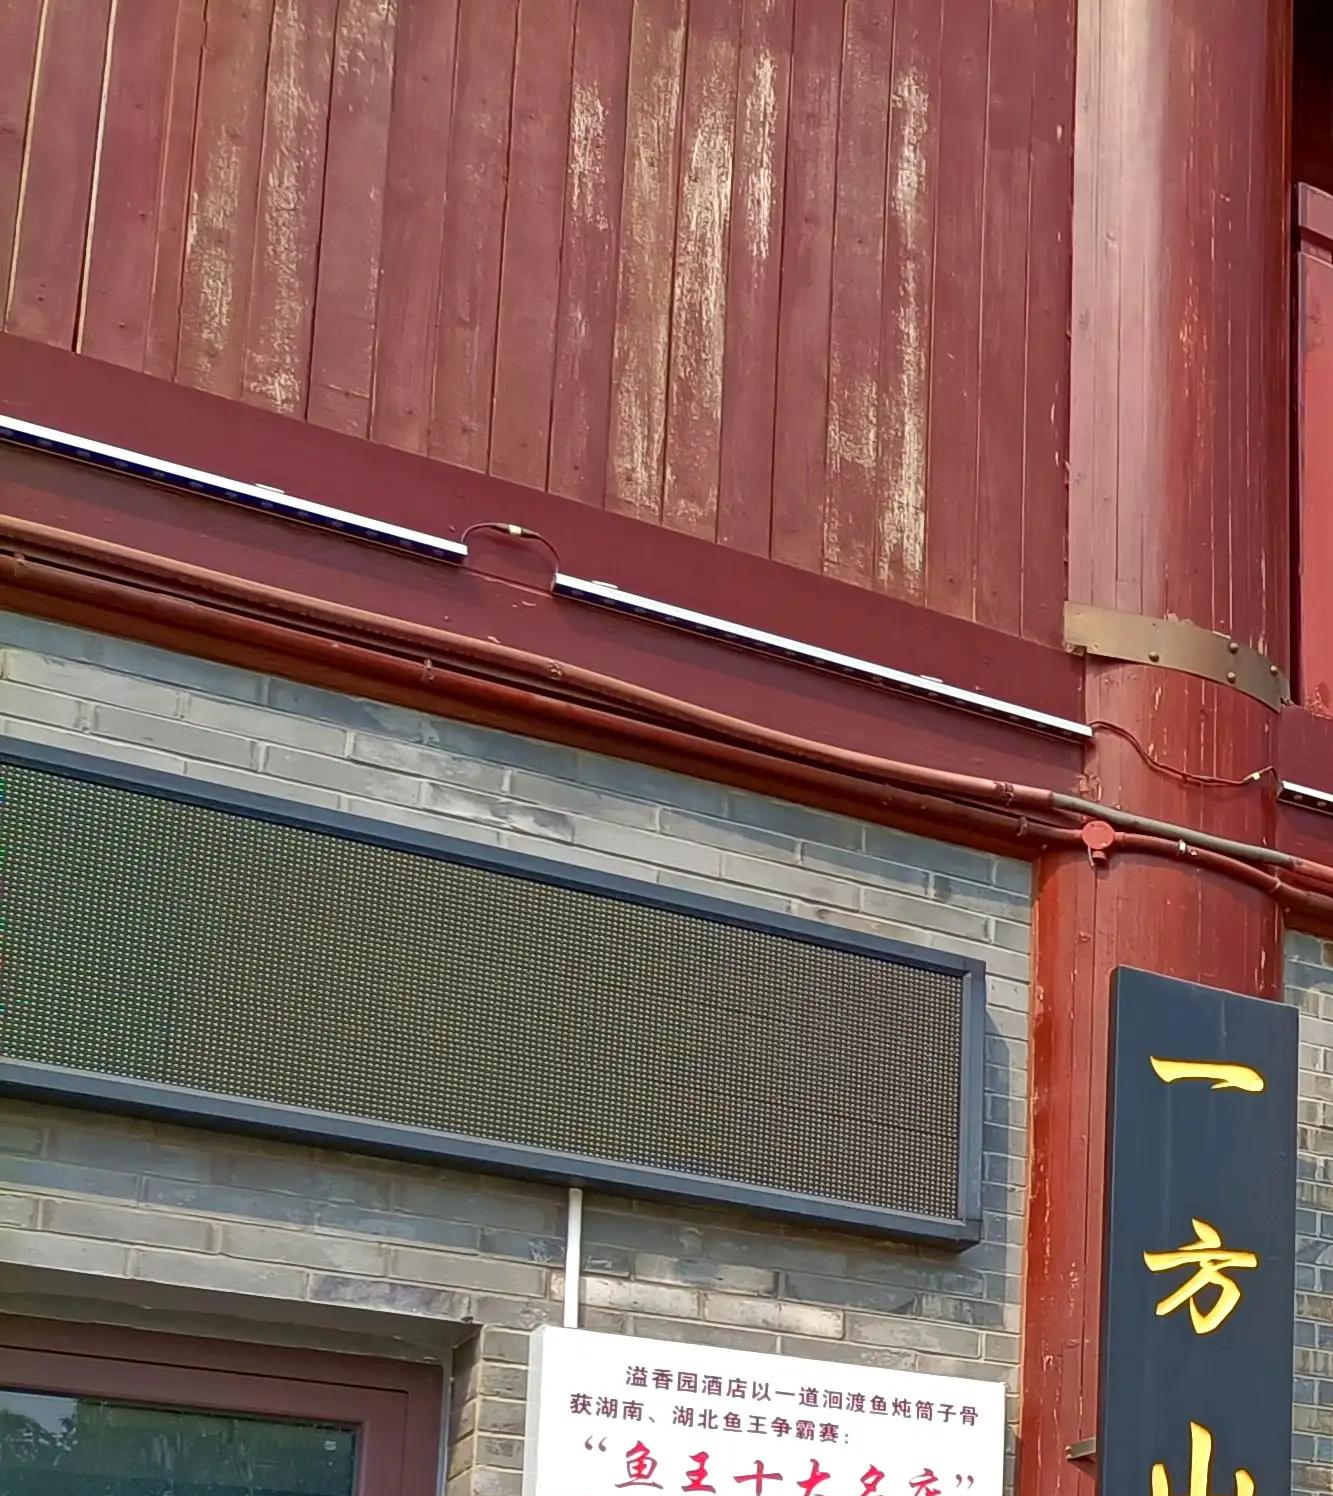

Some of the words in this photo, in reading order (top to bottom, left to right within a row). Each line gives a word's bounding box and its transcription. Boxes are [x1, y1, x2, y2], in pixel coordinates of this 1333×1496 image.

[625, 1364, 980, 1427] 溢香园酒店以一道洄渡鱼炖筒子骨
